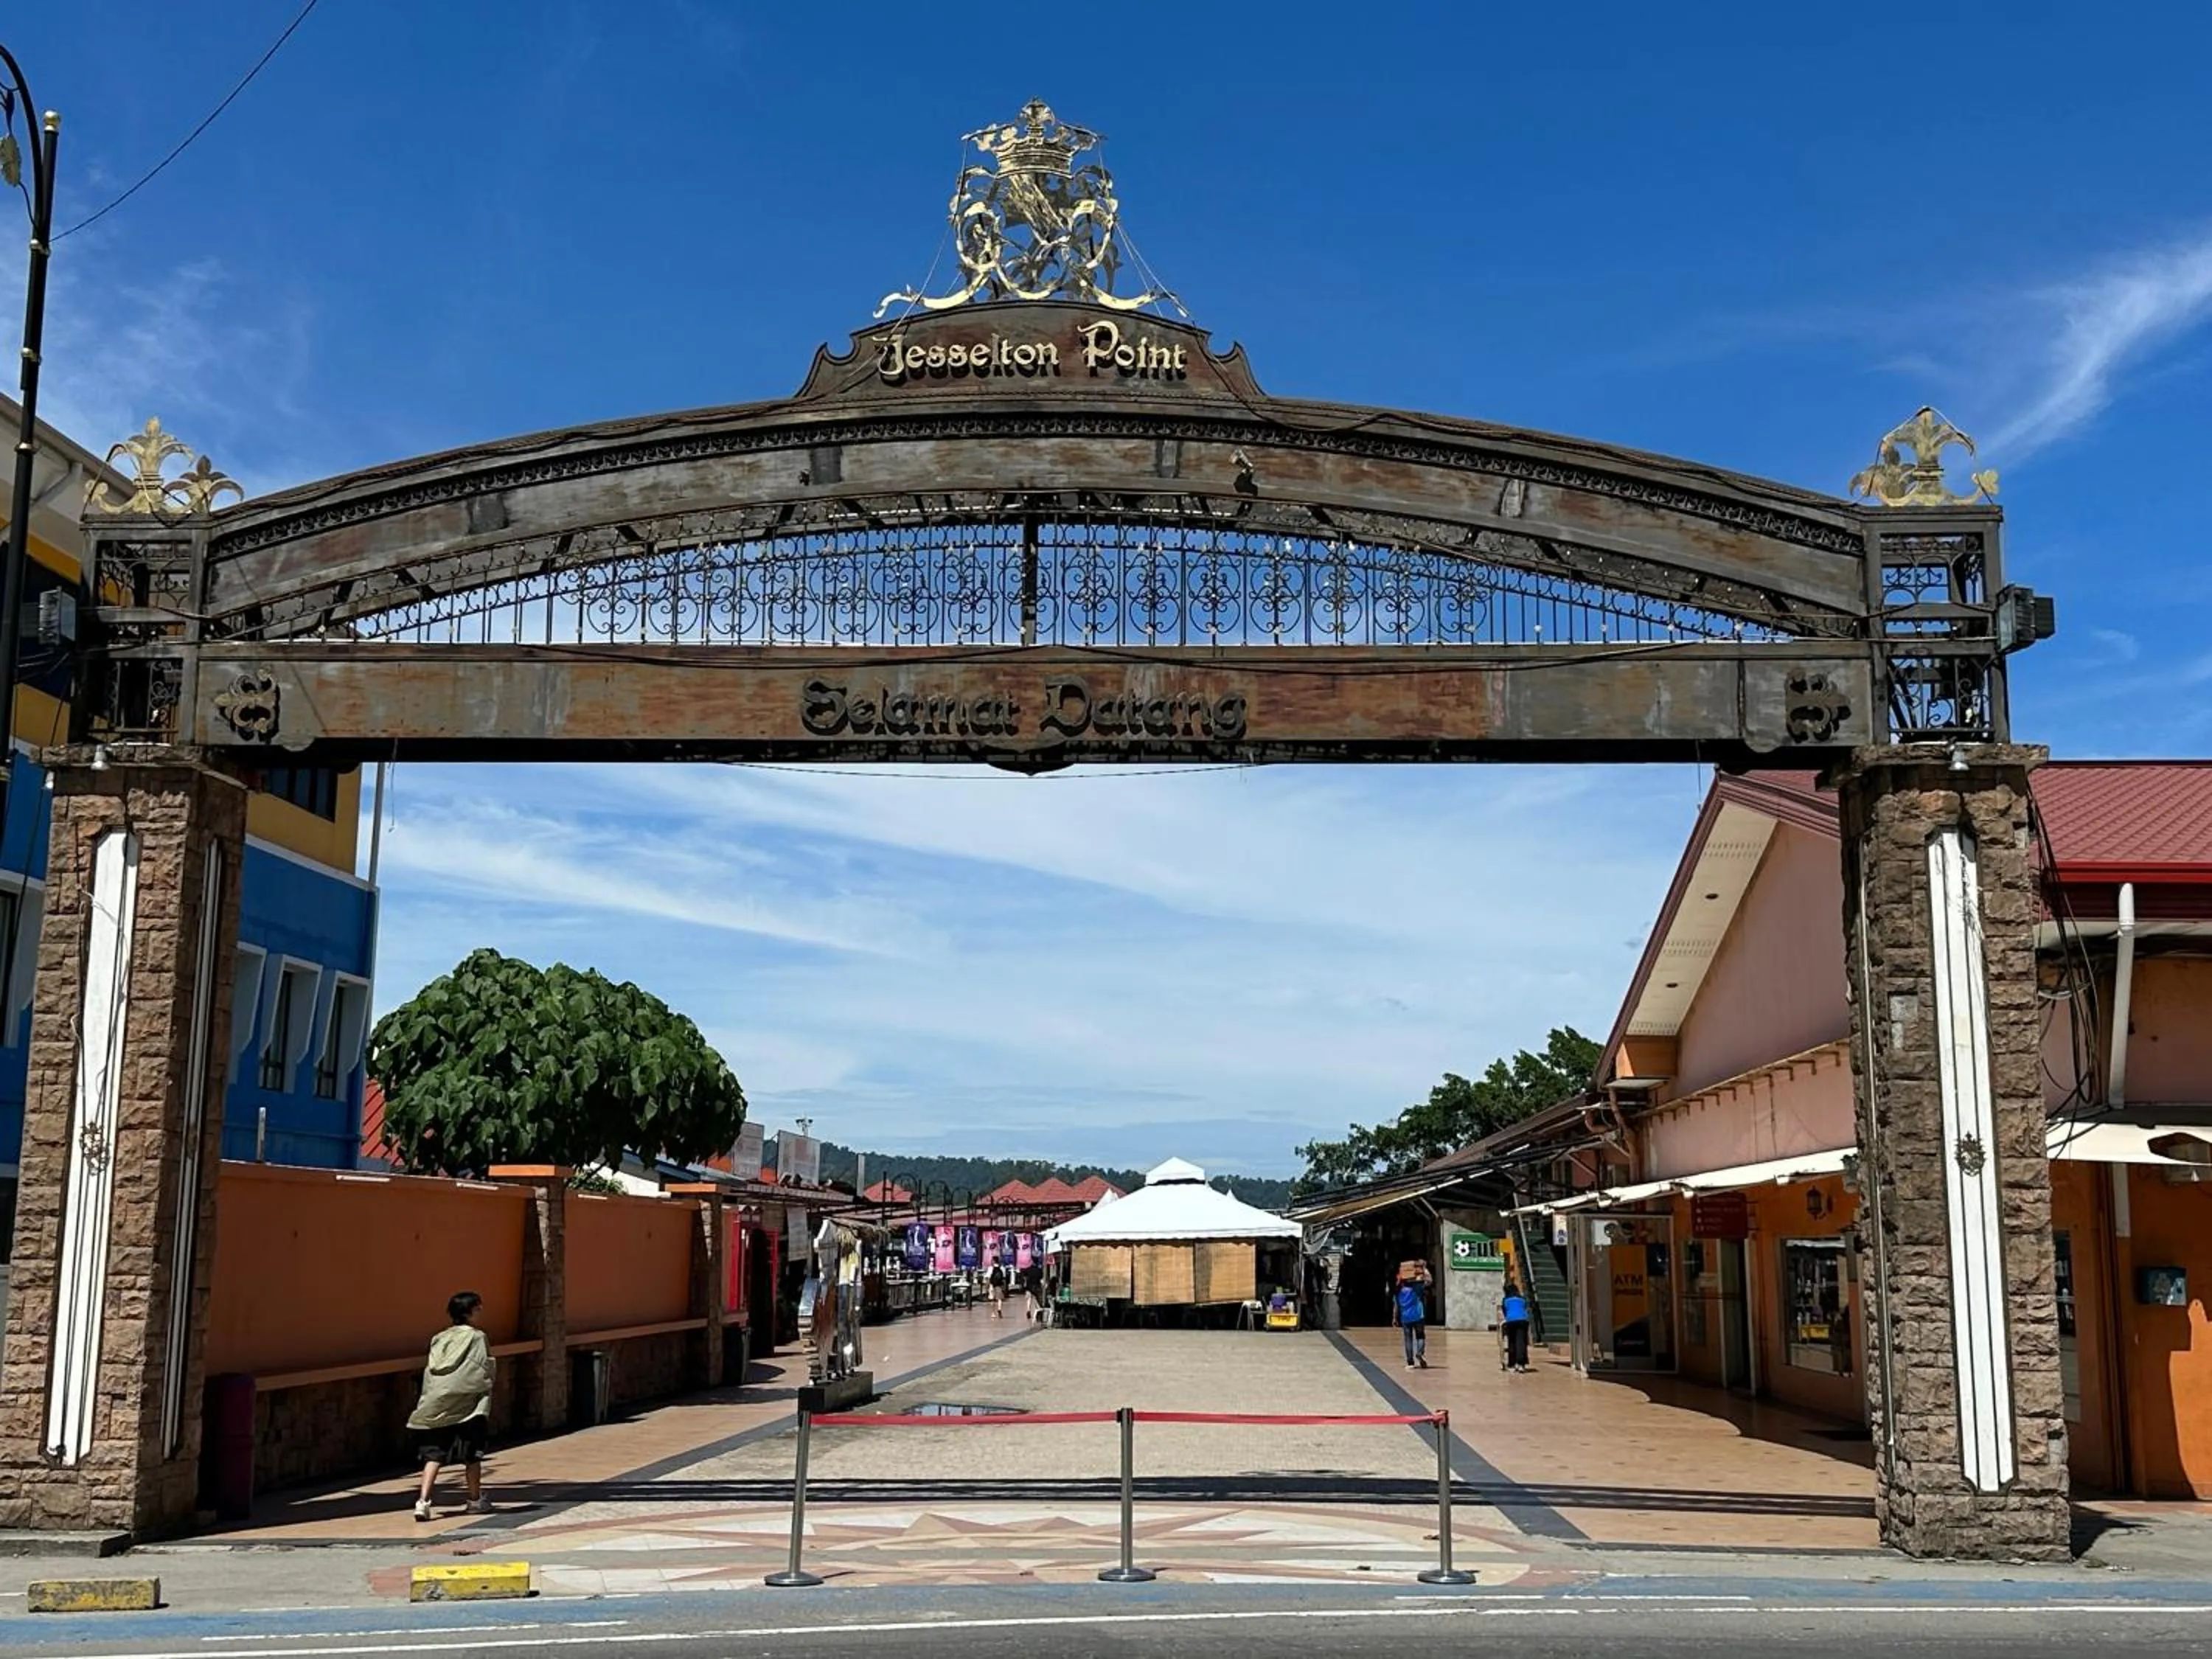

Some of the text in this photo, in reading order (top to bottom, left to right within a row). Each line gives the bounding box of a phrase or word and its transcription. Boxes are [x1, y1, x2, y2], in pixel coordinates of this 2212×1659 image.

[873, 321, 1186, 377] Jesselton Point
[801, 674, 1247, 738] Selamat Datang
[1615, 1274, 1644, 1286] ATM
